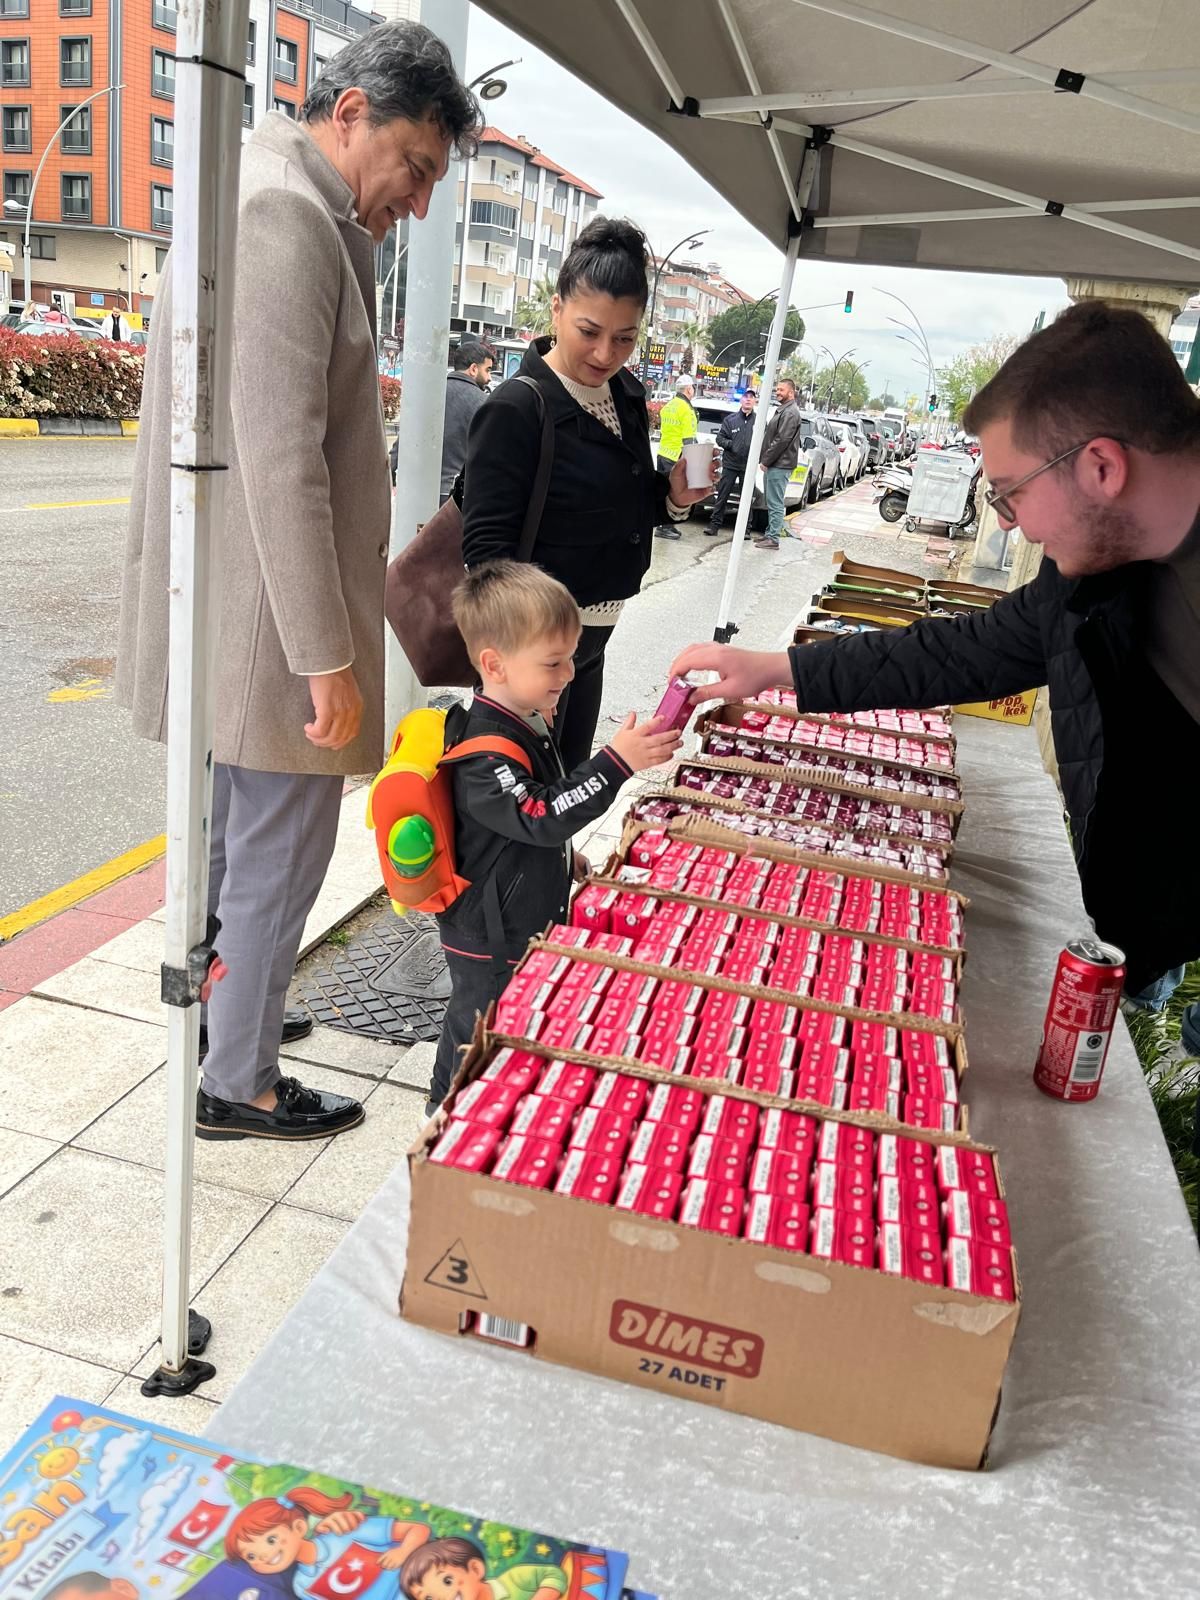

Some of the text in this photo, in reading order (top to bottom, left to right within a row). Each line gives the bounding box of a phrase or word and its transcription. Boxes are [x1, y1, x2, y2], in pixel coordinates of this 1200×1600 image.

[649, 345, 665, 353] URFA
[1004, 704, 1028, 716] kek
[551, 784, 589, 816] THERE
[583, 776, 602, 796] IS
[446, 1255, 469, 1285] 3
[617, 1308, 756, 1368] DİMES
[638, 1357, 727, 1392] 27 ADET
[15, 1532, 85, 1592] Kitabı
